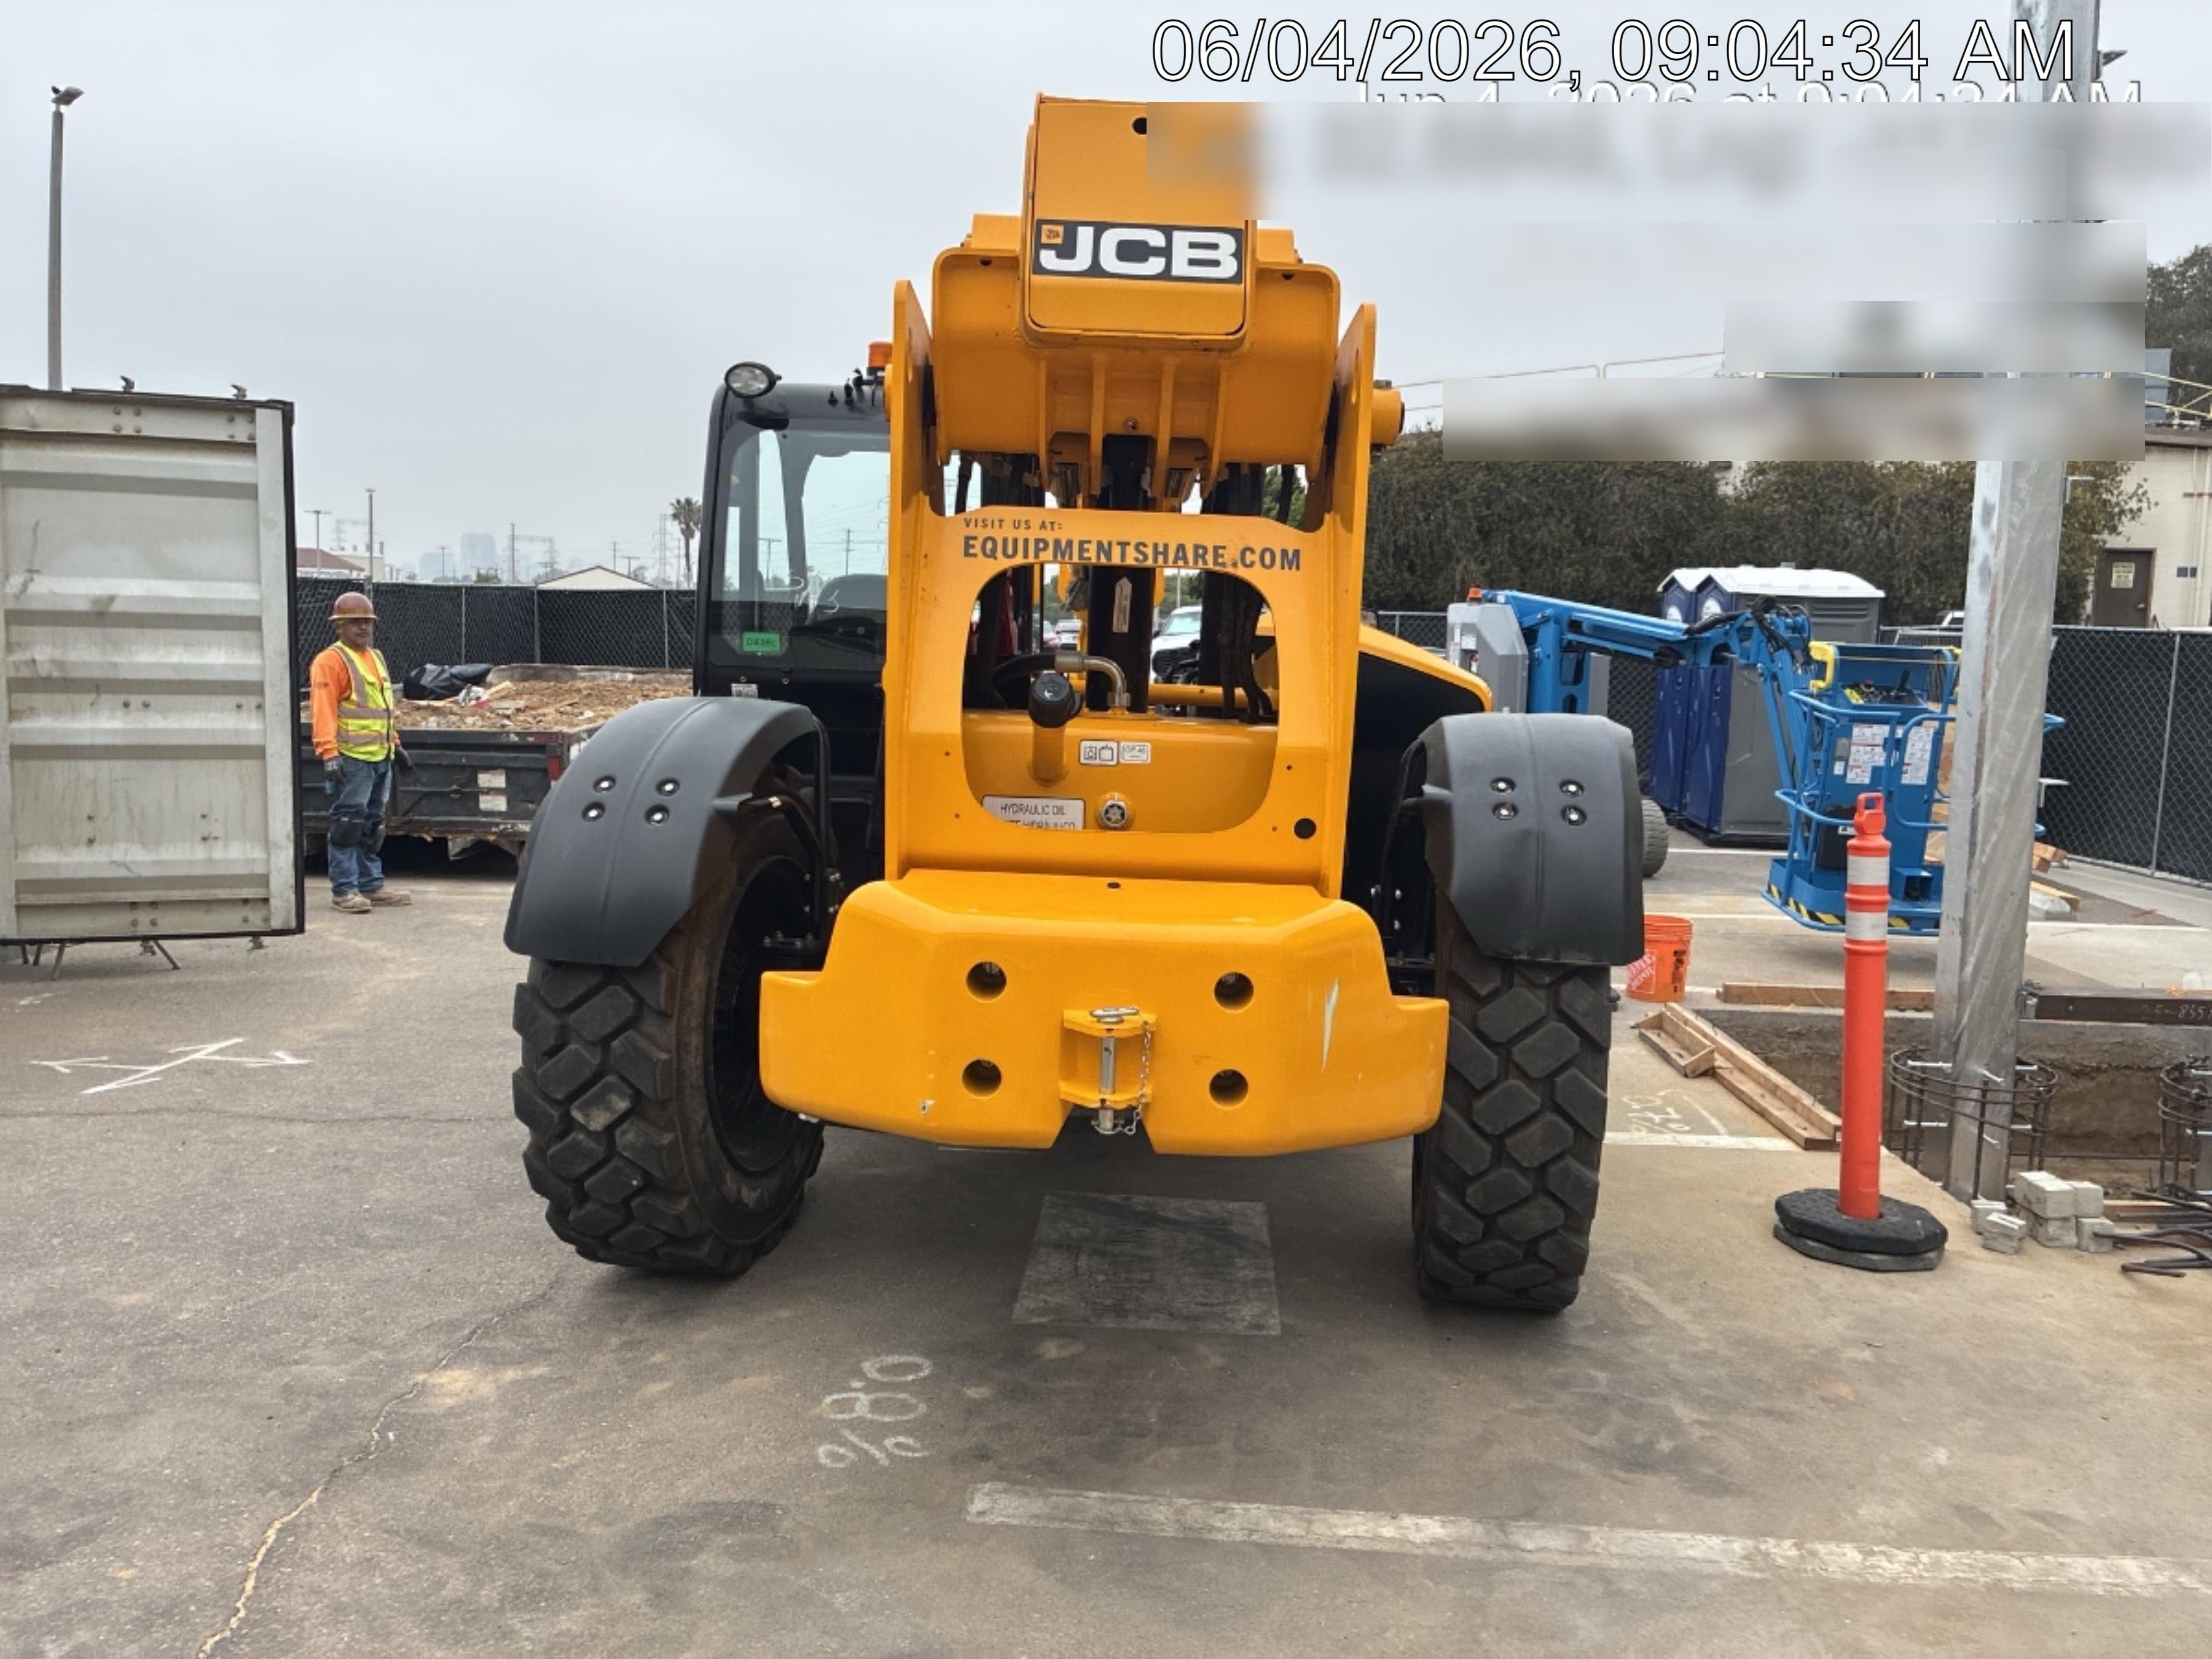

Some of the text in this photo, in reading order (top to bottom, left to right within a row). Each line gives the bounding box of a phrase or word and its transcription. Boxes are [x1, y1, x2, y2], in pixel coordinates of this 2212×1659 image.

[1039, 226, 1237, 279] JCB
[963, 517, 1063, 531] VISIT US AT:
[963, 535, 1301, 571] EQUIPMENTSHARE.COM
[1000, 803, 1065, 816] HYDRAULIC OIL
